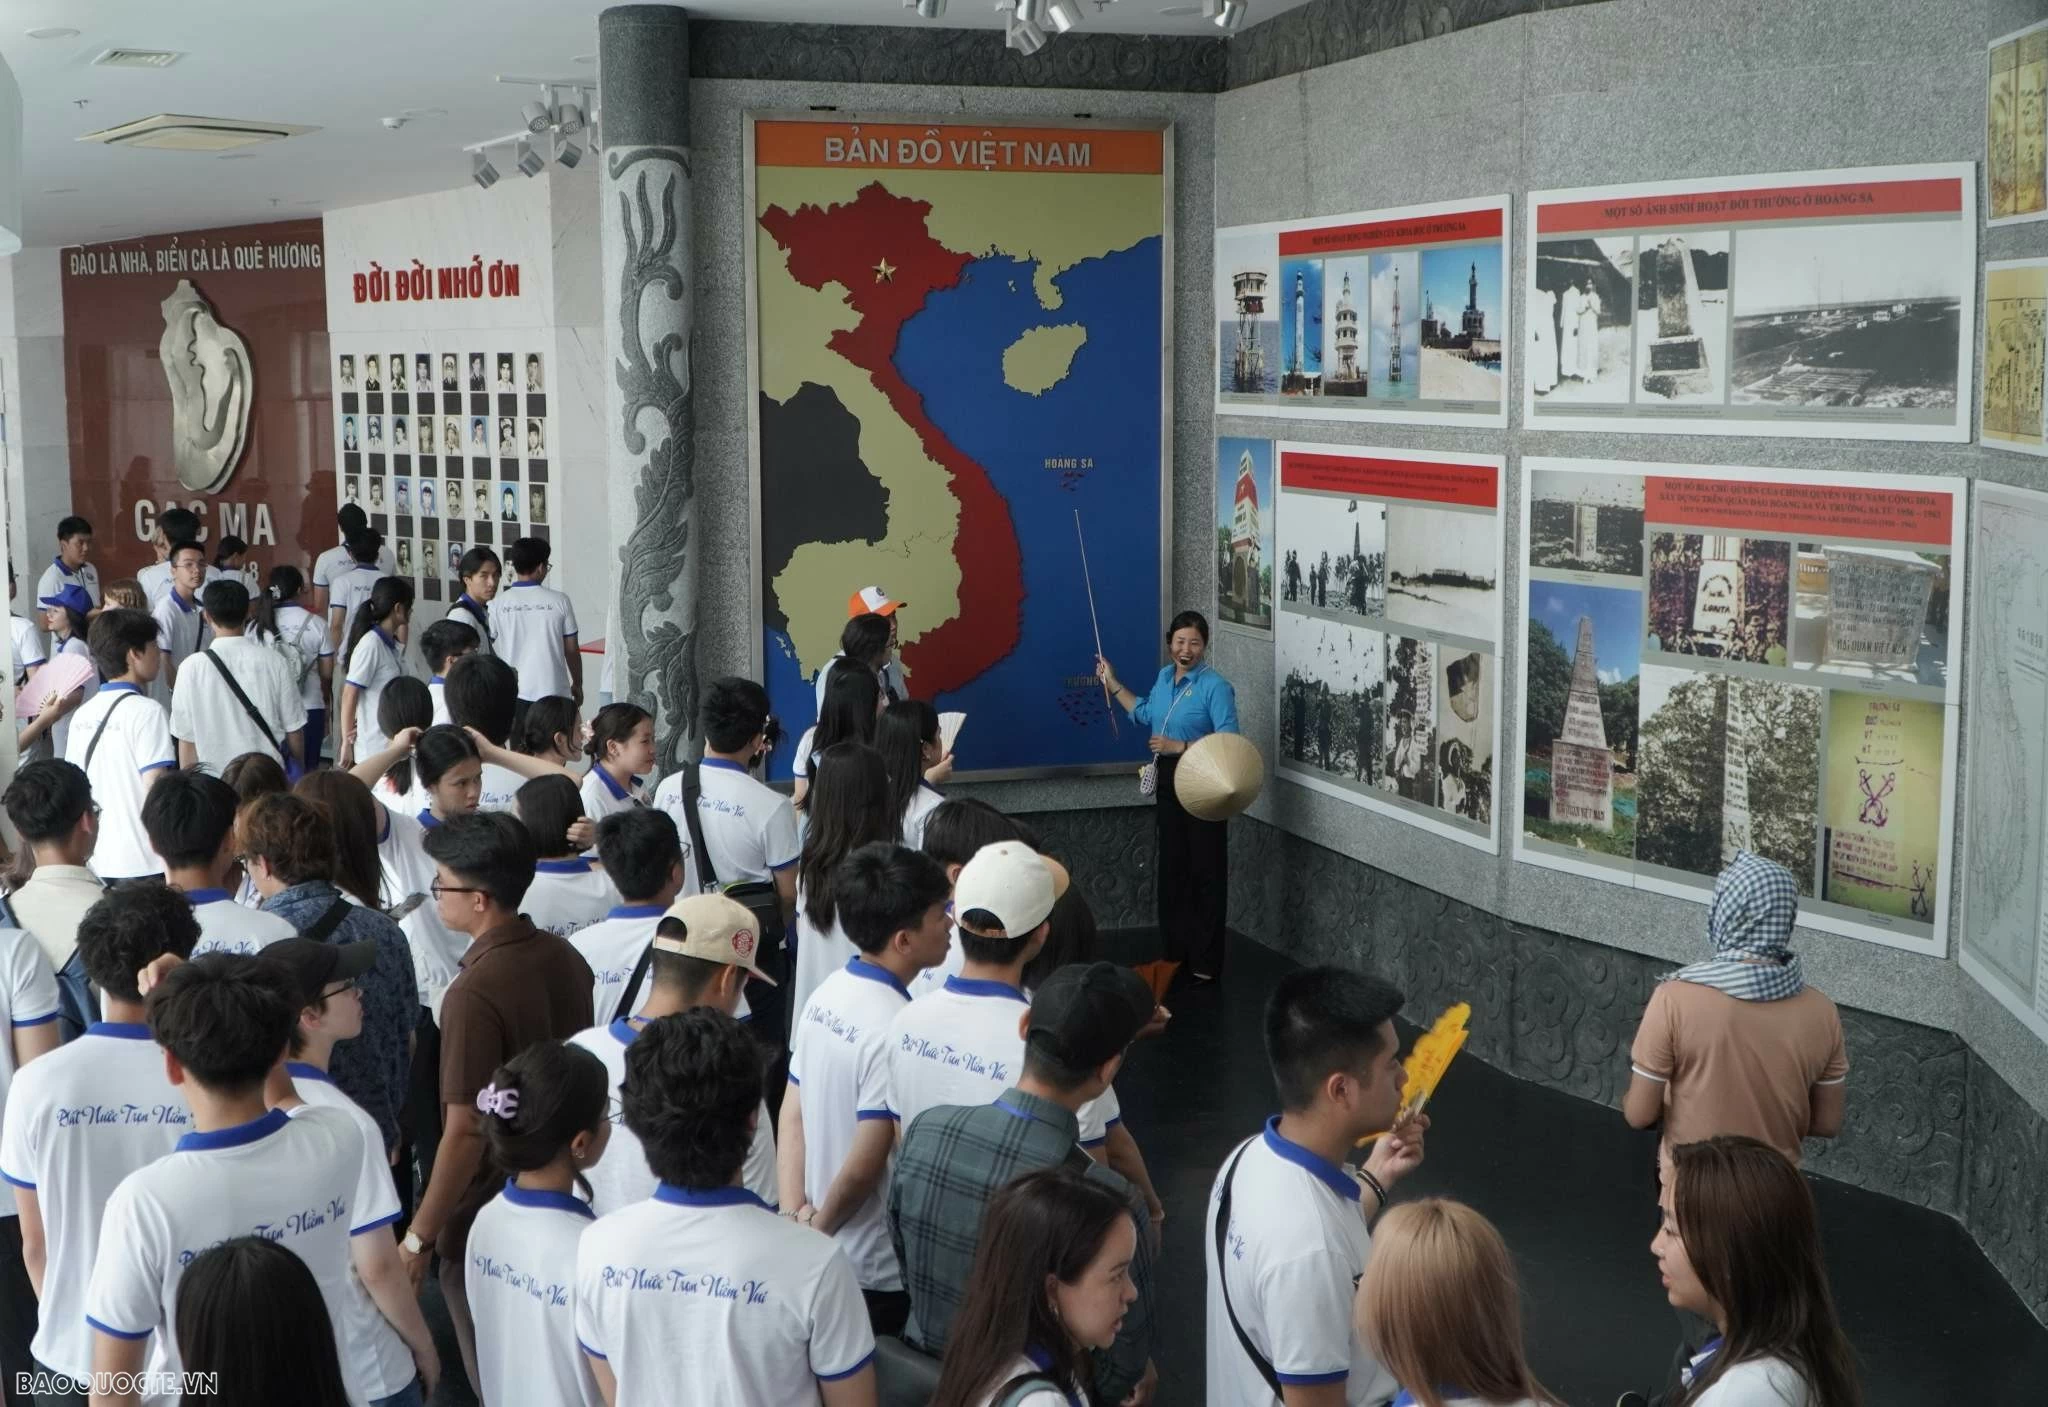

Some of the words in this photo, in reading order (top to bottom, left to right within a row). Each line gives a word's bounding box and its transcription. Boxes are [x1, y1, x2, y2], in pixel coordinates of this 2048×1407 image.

[825, 126, 889, 163] BẢN
[897, 128, 943, 165] ĐỒ
[949, 130, 1018, 171] VIỆT
[1023, 141, 1091, 167] NAM
[70, 244, 96, 275] ĐẢO
[100, 245, 117, 274] LÀ
[120, 244, 153, 275] NHÀ,
[156, 236, 188, 272] BIỂN
[191, 239, 208, 271] CẢ
[212, 242, 230, 270] LÀ
[234, 240, 264, 270] QUÊ
[268, 241, 322, 268] HƯƠNG
[353, 261, 390, 303] ĐỜI
[395, 259, 433, 301] ĐỜI
[437, 254, 483, 299] NHỚ
[488, 259, 520, 298] ƠN
[1081, 457, 1094, 469] SA
[134, 499, 208, 543] GC
[218, 502, 277, 546] MA
